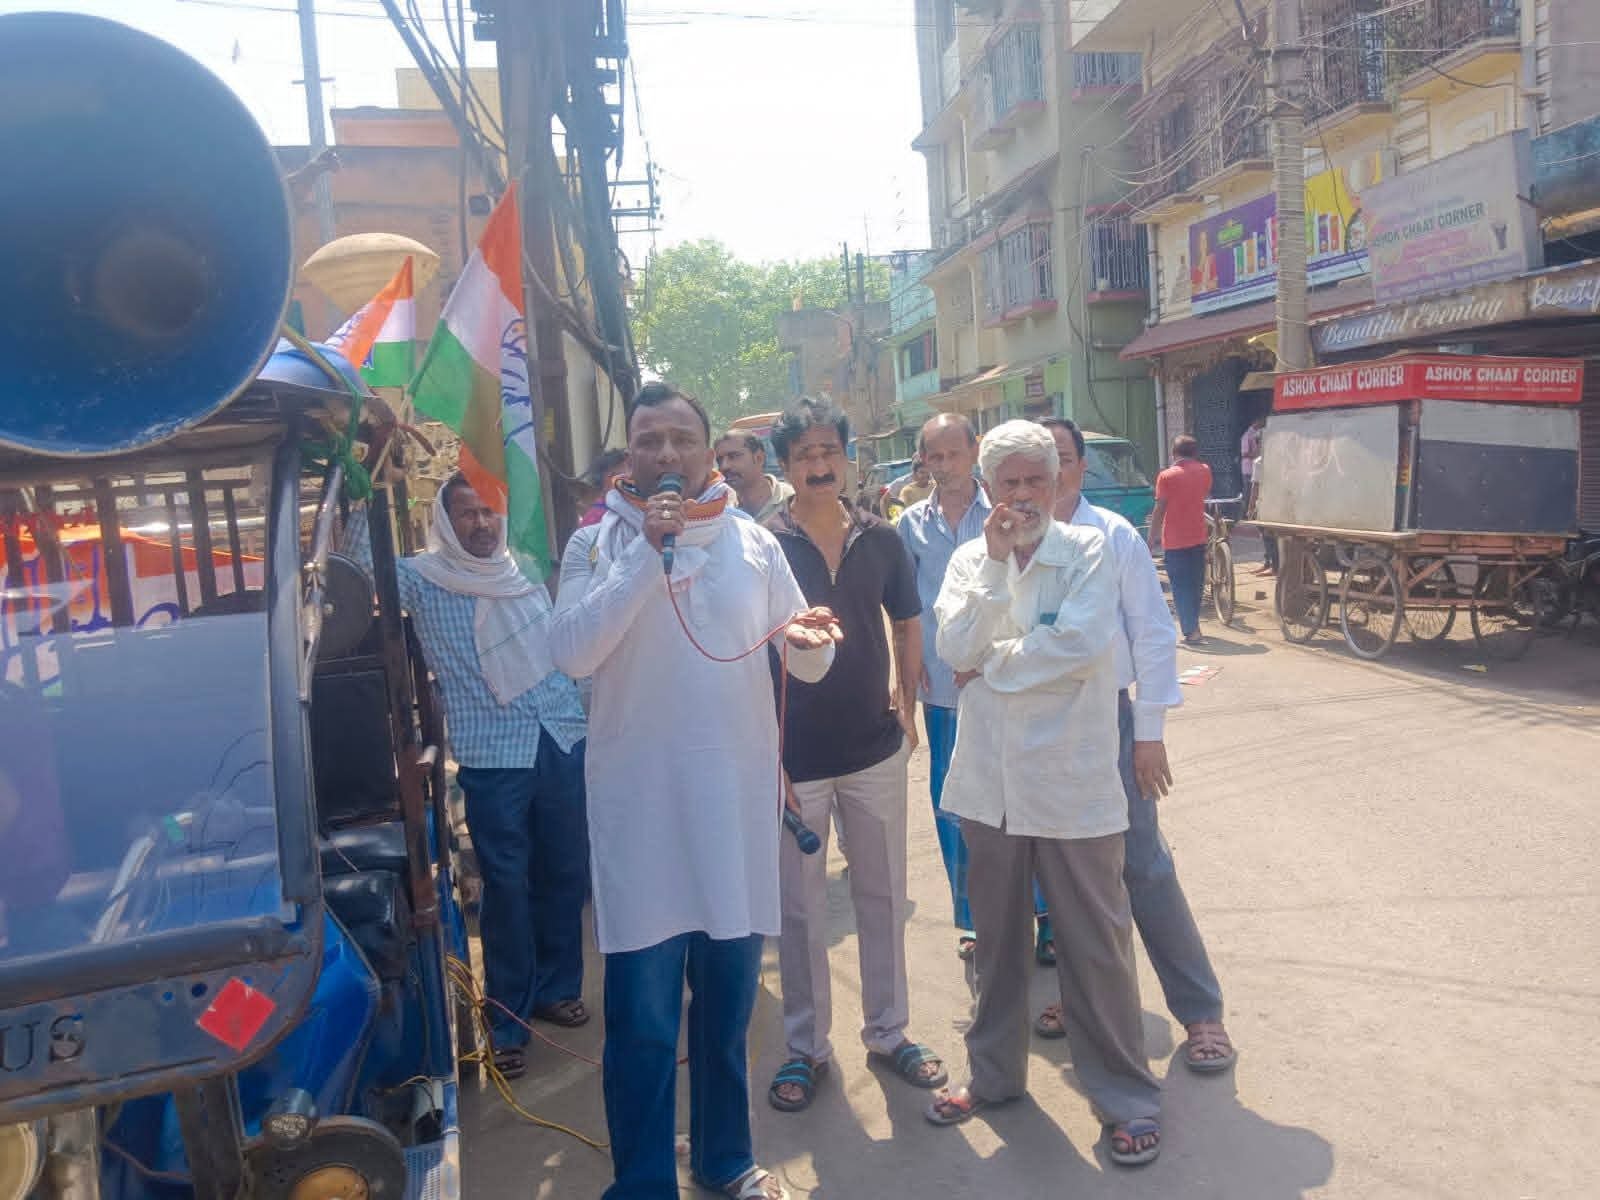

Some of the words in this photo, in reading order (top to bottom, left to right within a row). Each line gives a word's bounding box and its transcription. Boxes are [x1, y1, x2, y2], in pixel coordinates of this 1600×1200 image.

[1403, 218, 1435, 240] CHAAT
[1438, 202, 1485, 226] CORNER
[1321, 309, 1408, 345] Beautiful
[1411, 297, 1504, 328] Evening
[1282, 376, 1317, 397] ASHOK
[1319, 372, 1353, 393] CHAAT
[1356, 366, 1405, 390] CORNER
[1425, 366, 1472, 382] ASHOK
[1476, 367, 1519, 383] CHAAT
[1523, 368, 1576, 383] CORNER
